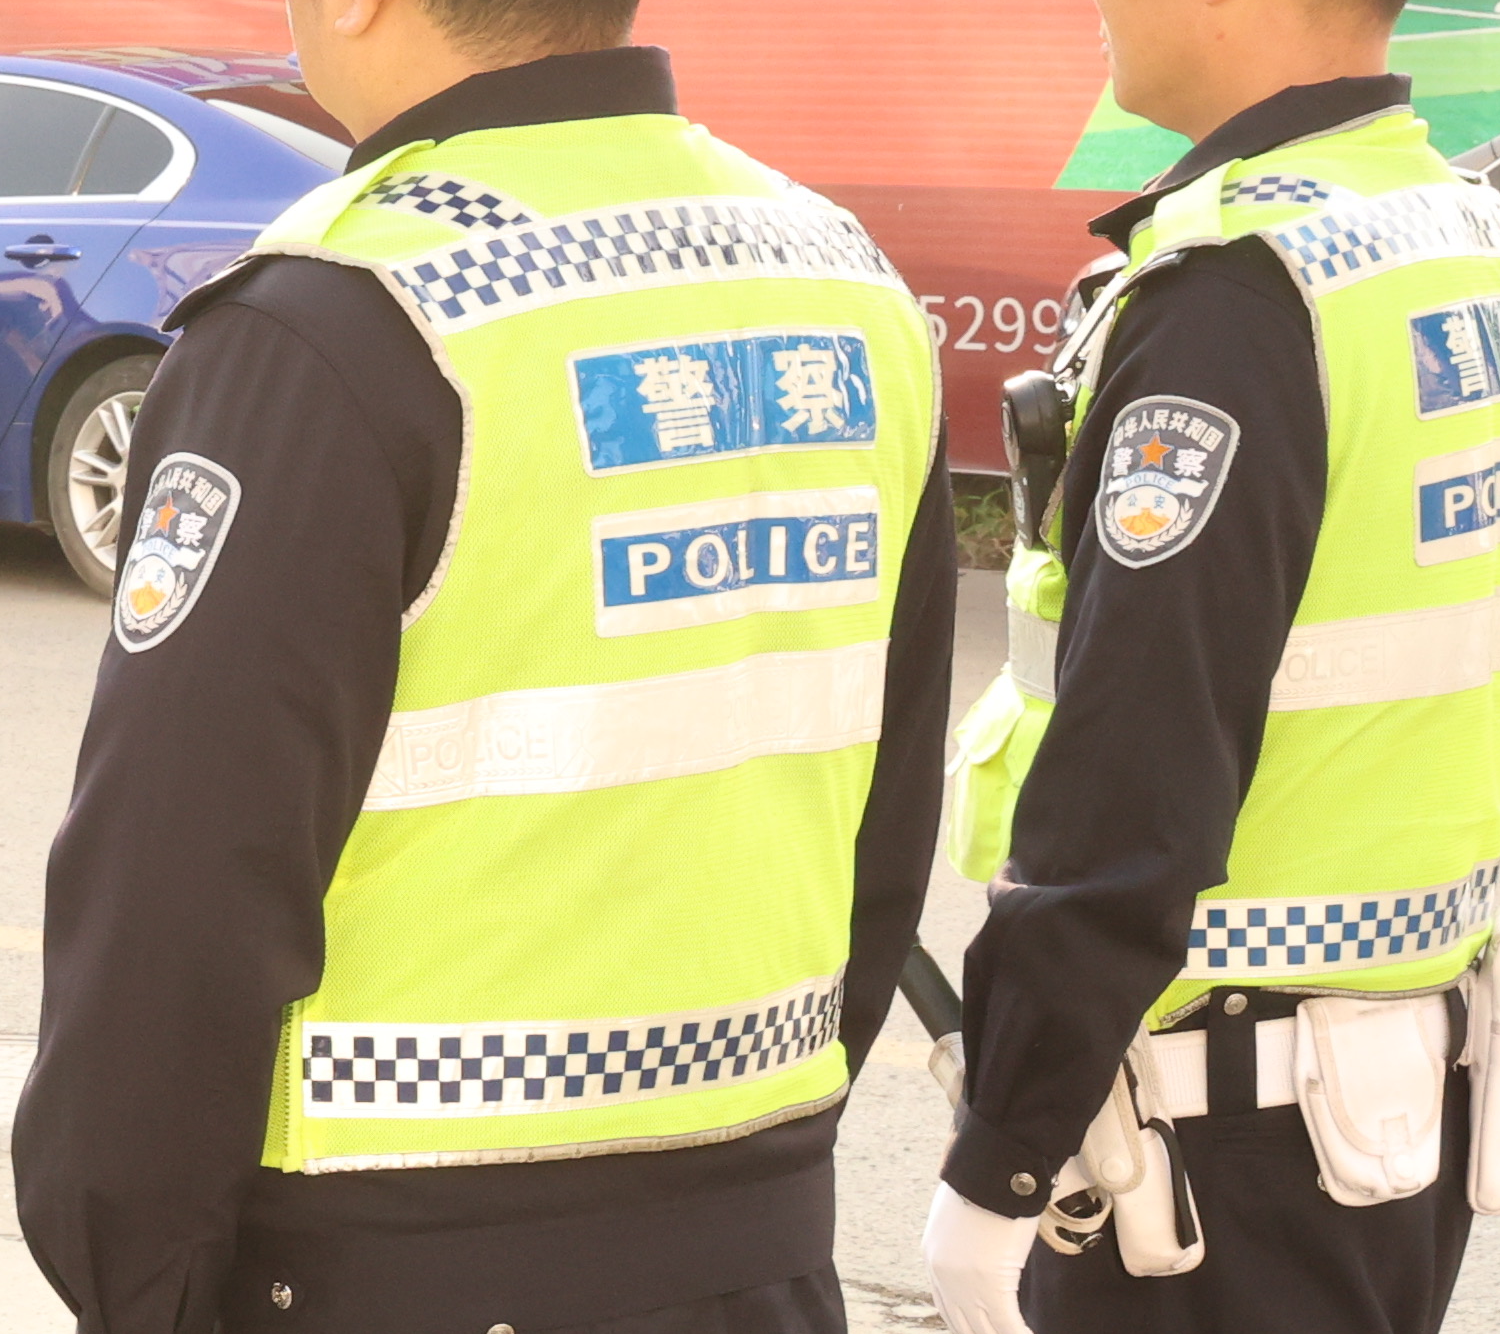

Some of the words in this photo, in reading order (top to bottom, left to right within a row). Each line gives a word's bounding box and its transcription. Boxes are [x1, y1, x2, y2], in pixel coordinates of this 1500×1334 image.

[634, 344, 846, 452] 警察
[1113, 409, 1224, 452] 中华人民共和国
[1112, 447, 1207, 477] 警察
[1125, 471, 1175, 489] POLICE
[627, 521, 871, 595] POLICE
